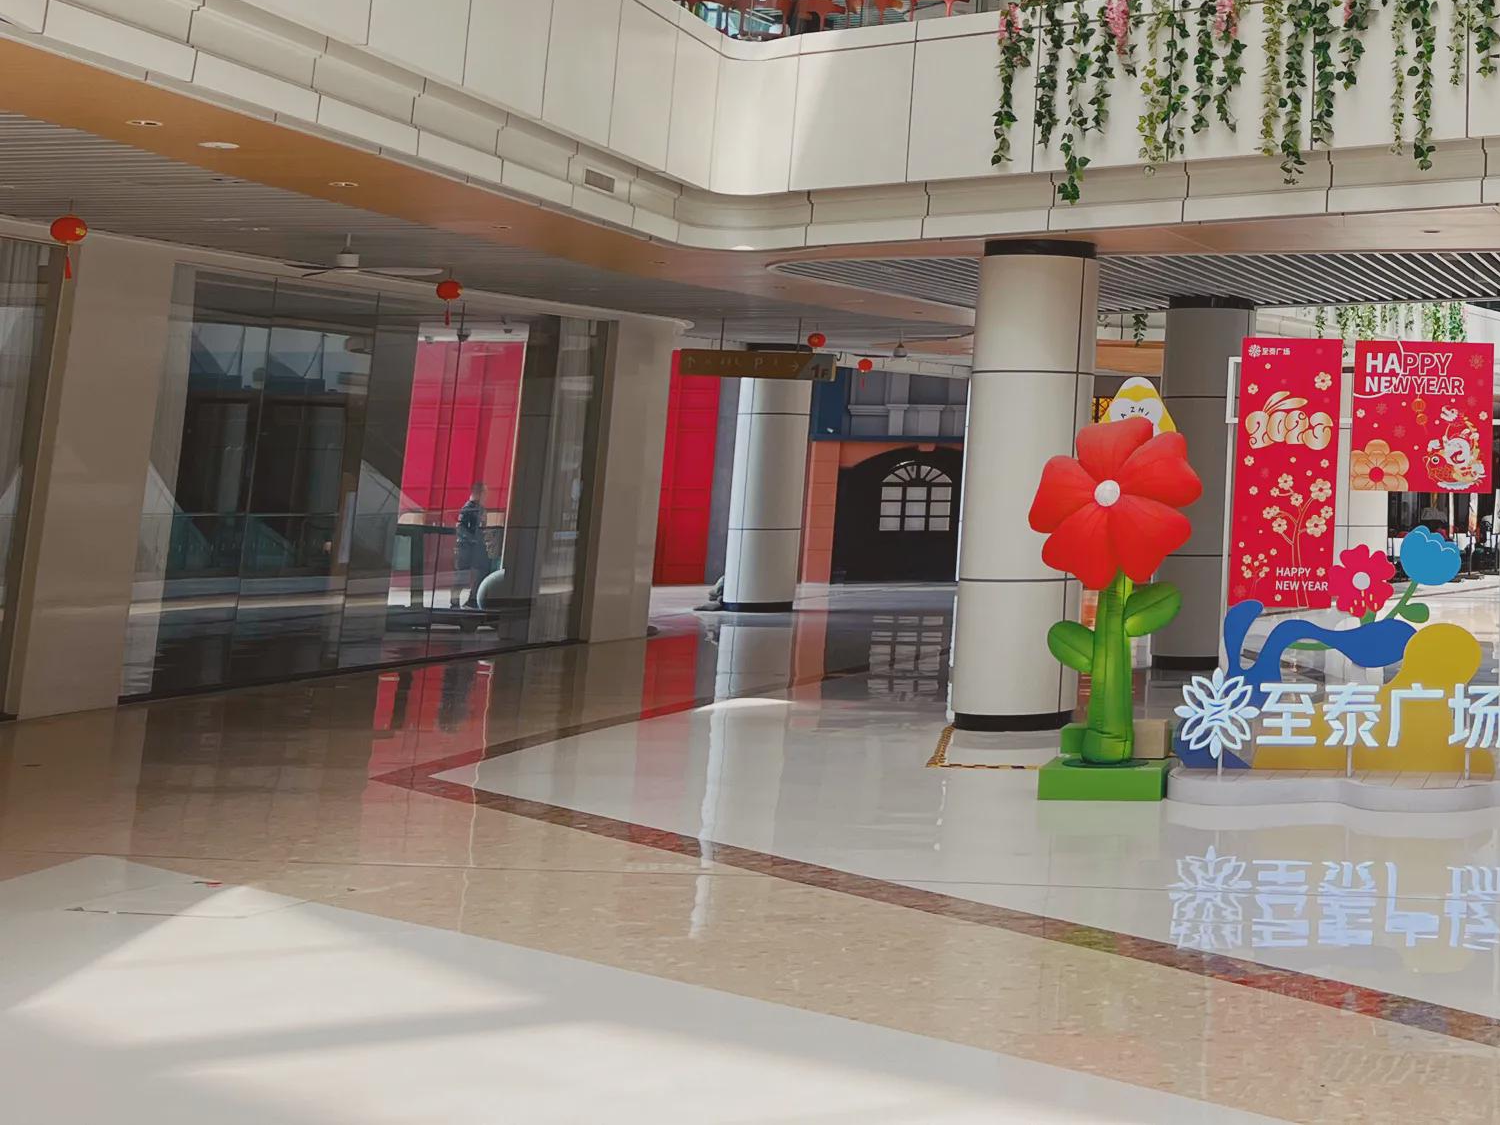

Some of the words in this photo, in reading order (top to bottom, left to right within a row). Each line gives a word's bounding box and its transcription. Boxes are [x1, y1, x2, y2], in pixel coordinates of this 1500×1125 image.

[1366, 352, 1452, 375] HAPPY
[1365, 376, 1411, 394] NEW
[1412, 376, 1464, 395] YEAR
[1245, 410, 1334, 451] 2023
[1276, 566, 1311, 577] HAPPY
[1275, 580, 1300, 591] NEW
[1301, 581, 1329, 592] YEAR
